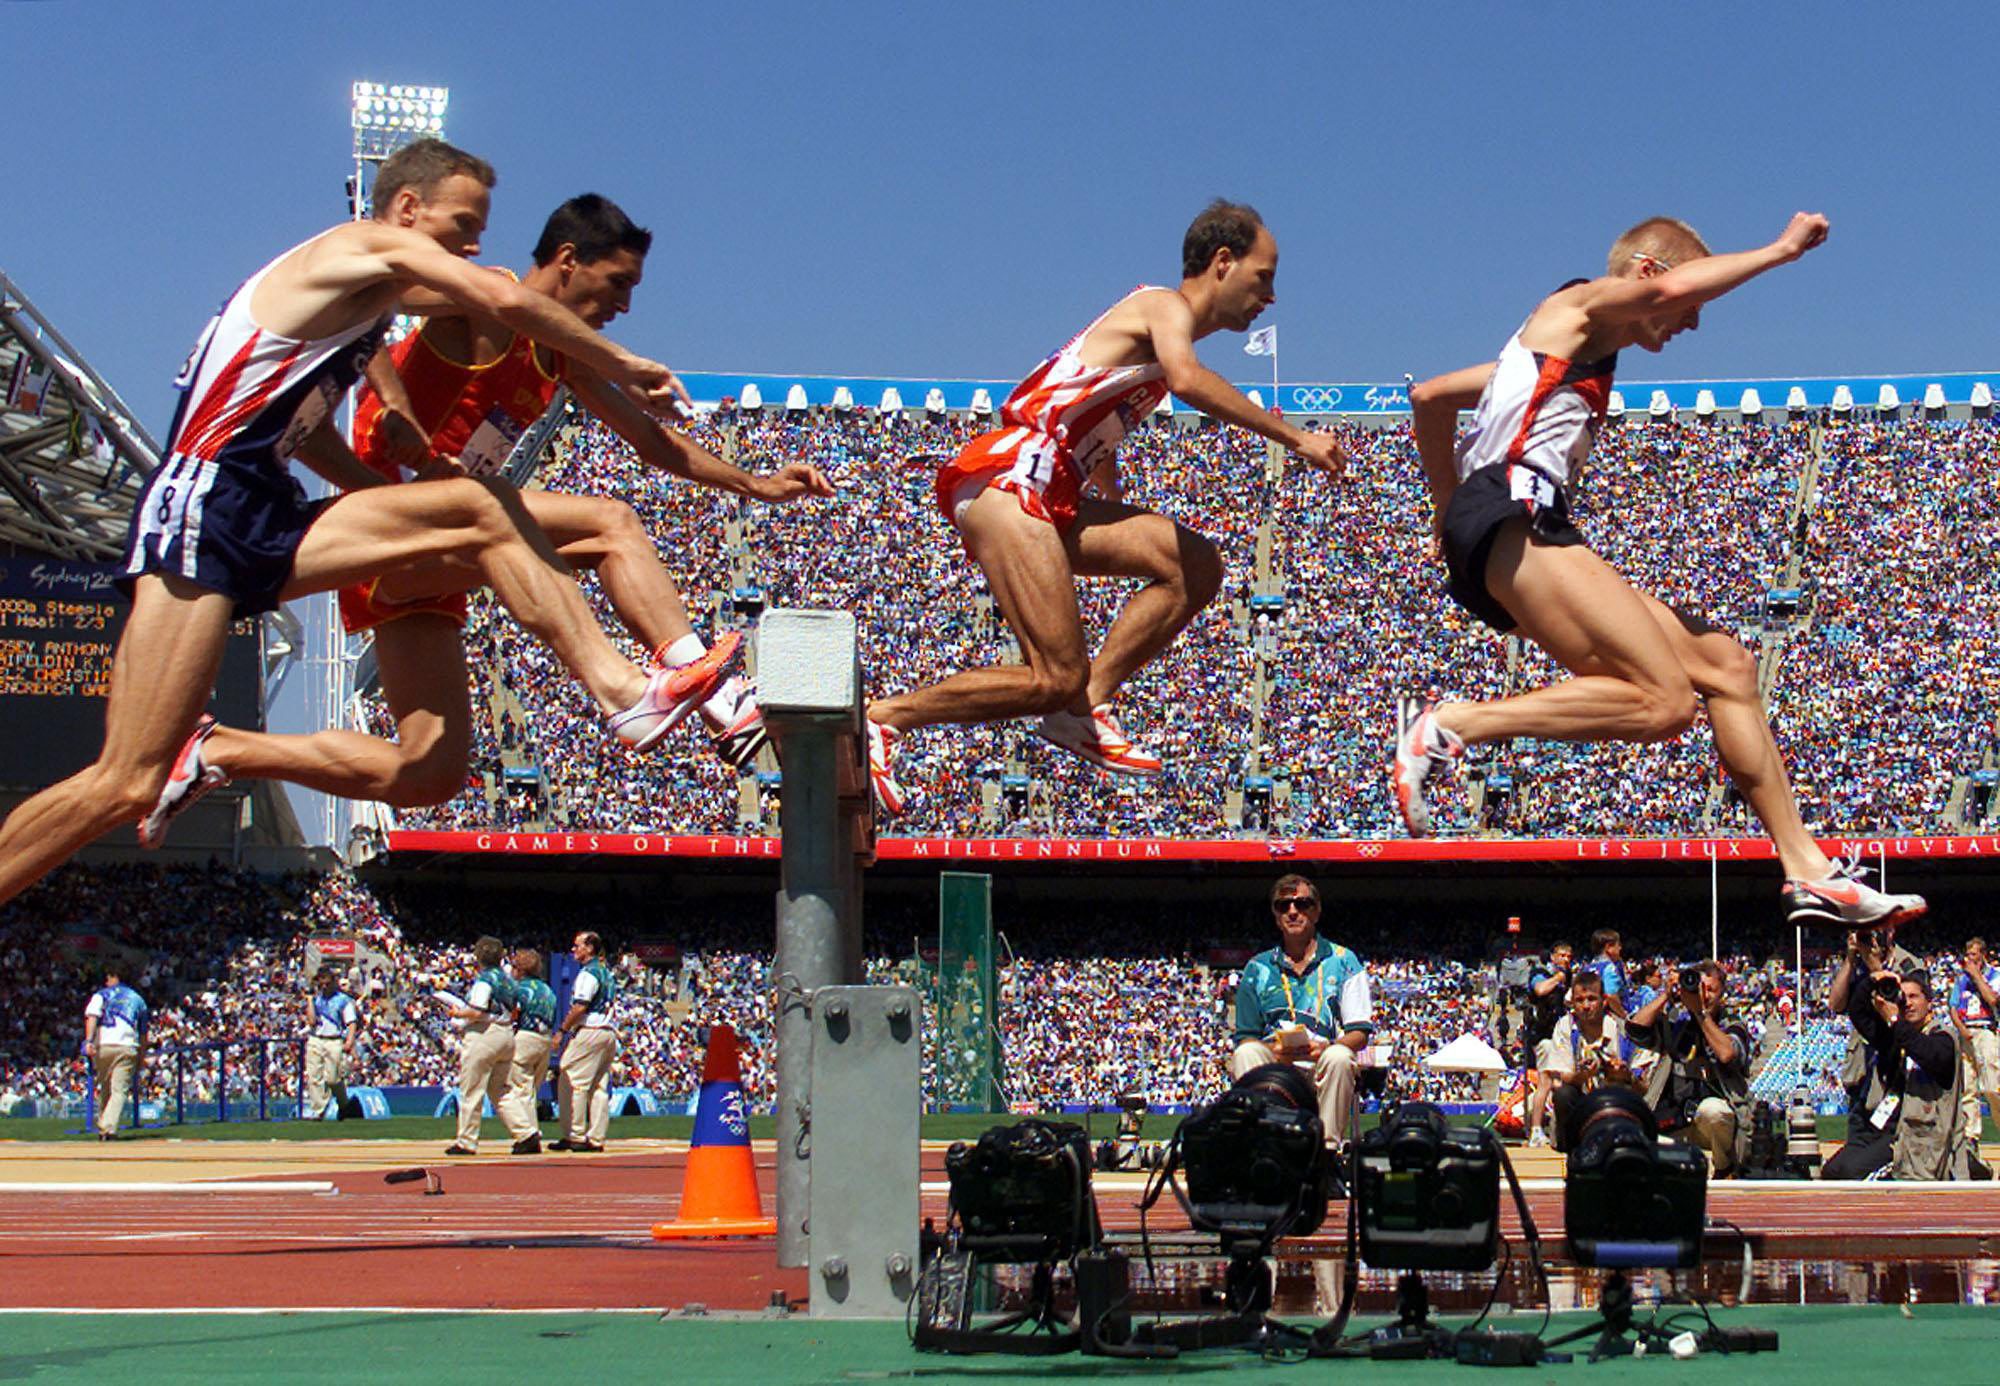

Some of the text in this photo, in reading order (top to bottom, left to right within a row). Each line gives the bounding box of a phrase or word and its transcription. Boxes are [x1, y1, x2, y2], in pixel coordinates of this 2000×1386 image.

[1026, 453, 1042, 481] 1
[158, 485, 177, 525] 8
[30, 564, 90, 592] Sydney
[476, 834, 773, 854] GAMES OF THE
[912, 841, 1162, 857] MILLENNIUM
[1576, 842, 1631, 857] LES
[1660, 841, 1741, 859] JEUX
